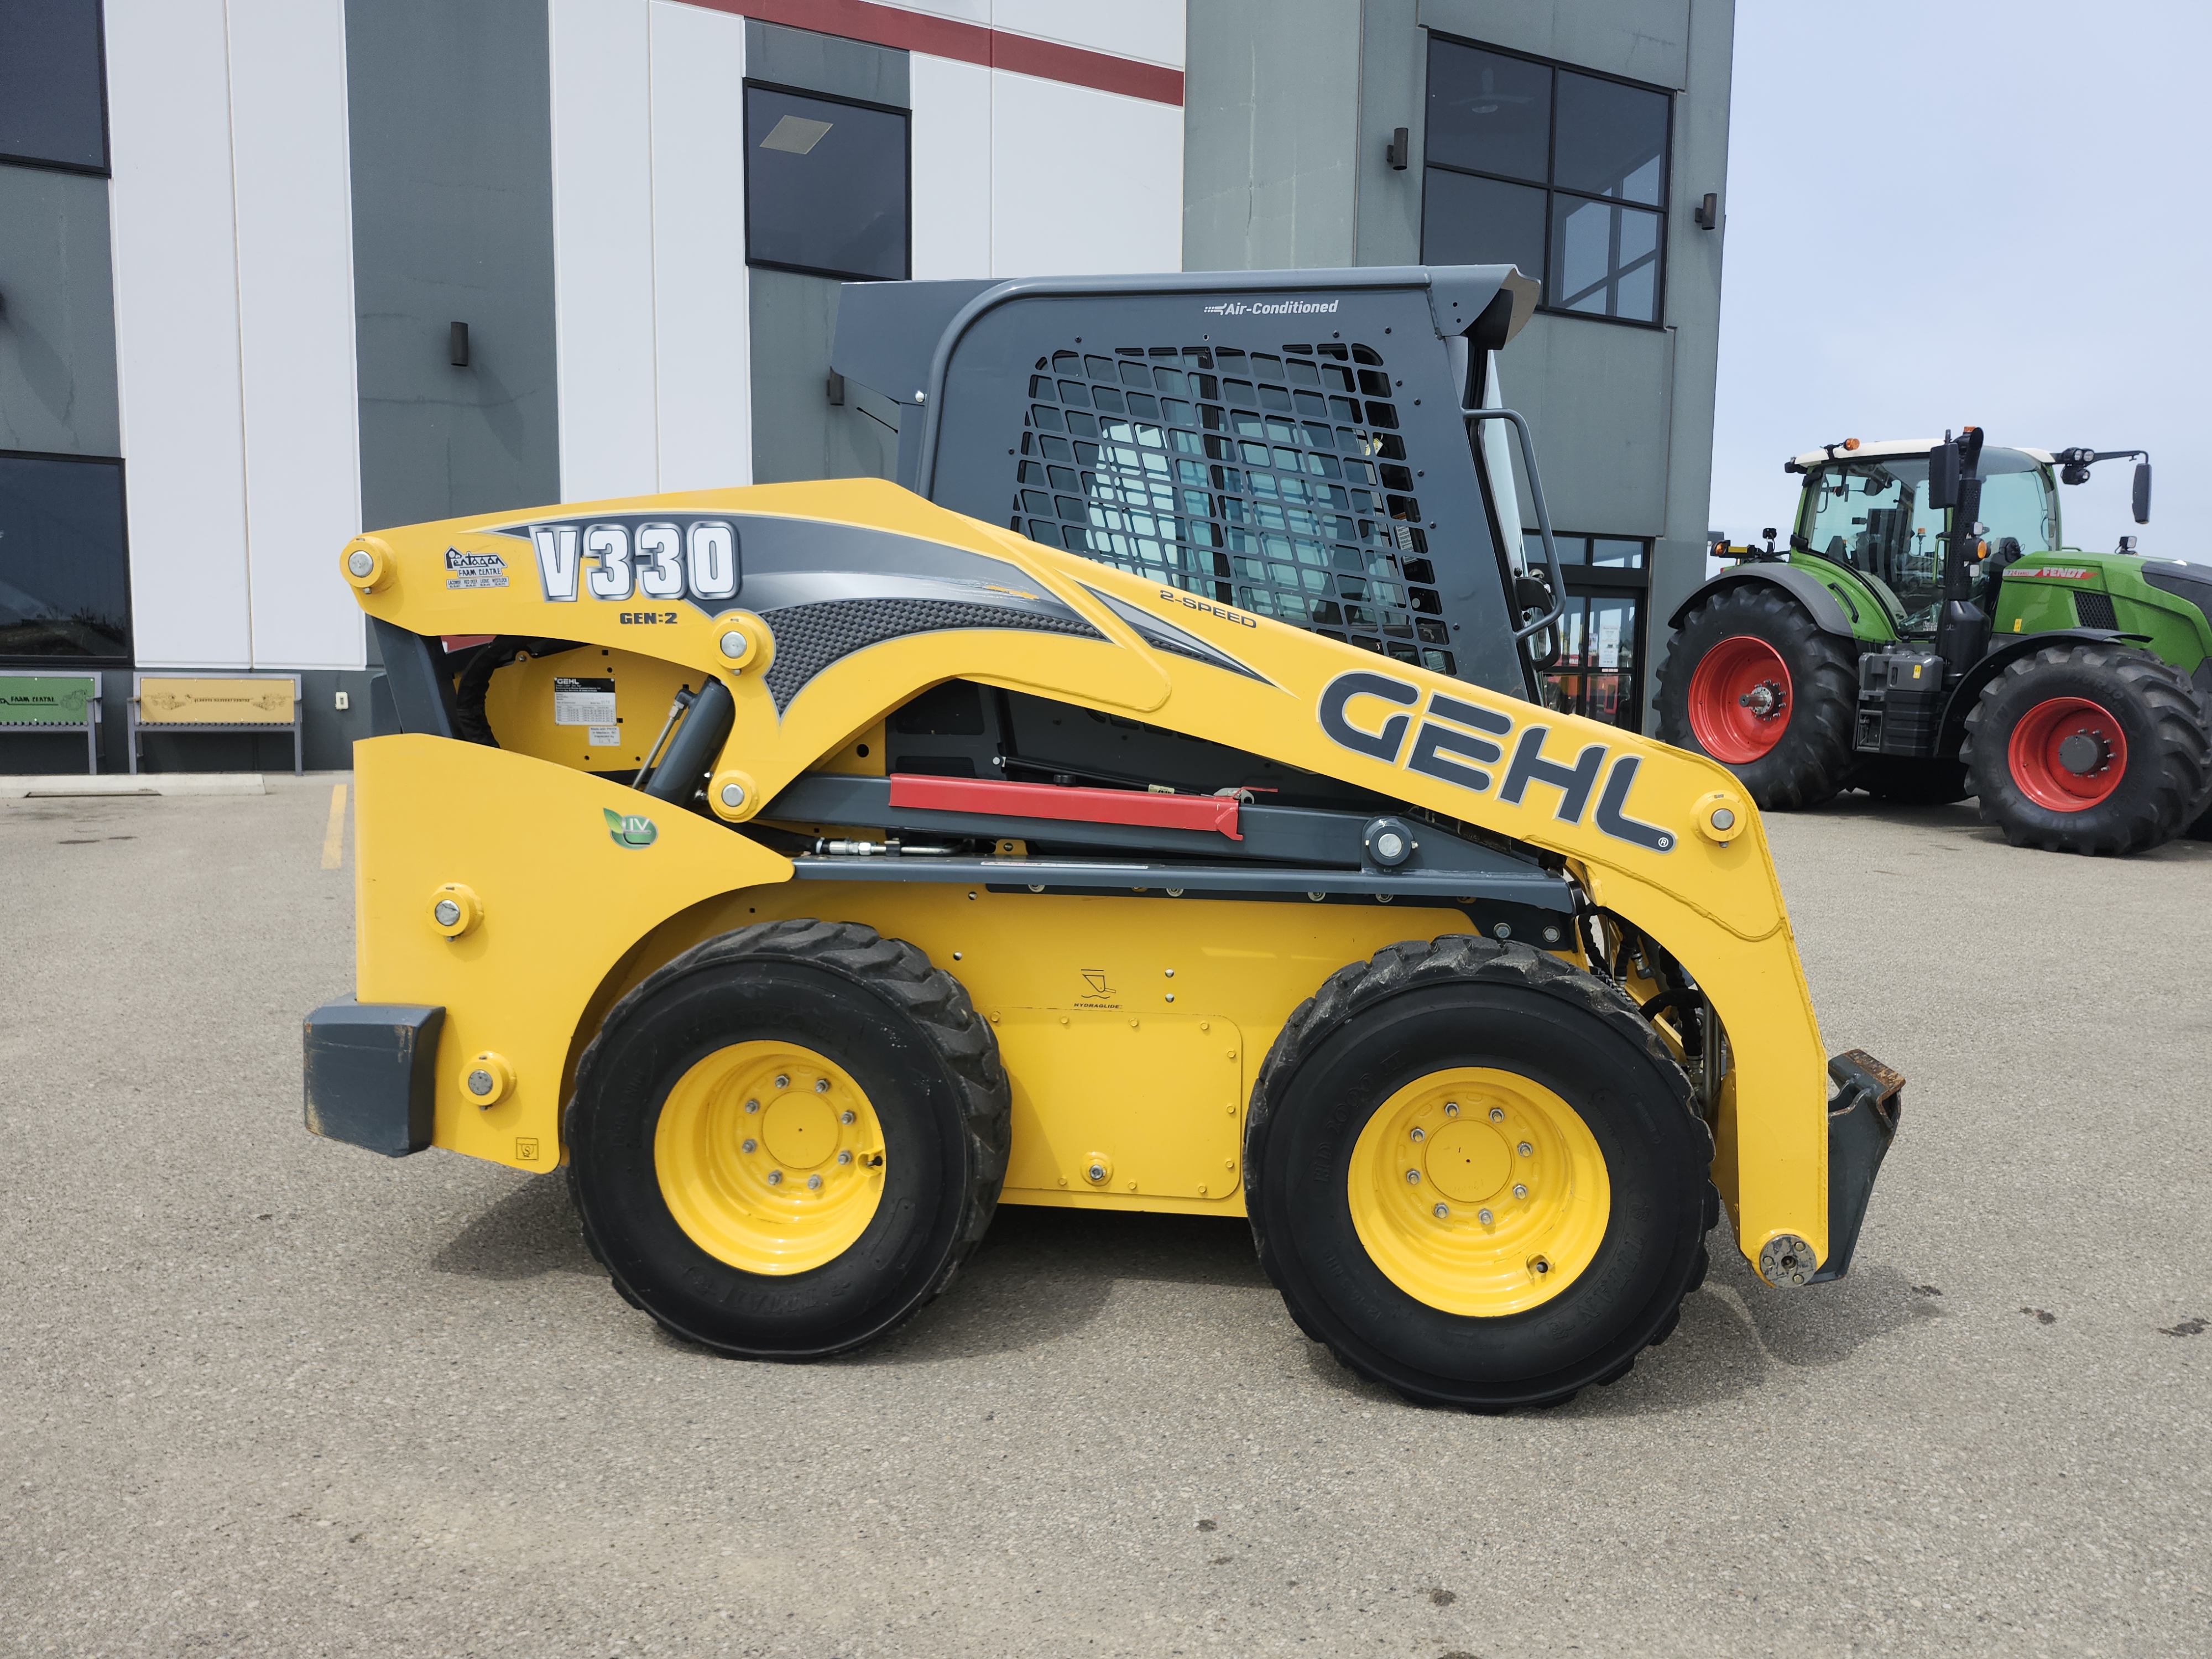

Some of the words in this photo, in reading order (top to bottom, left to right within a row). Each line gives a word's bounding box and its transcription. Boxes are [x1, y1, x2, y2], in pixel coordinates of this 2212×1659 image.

[1225, 300, 1339, 316] Air-Conditioned
[529, 521, 739, 602] V330
[2043, 567, 2086, 578] FENDT
[619, 612, 678, 625] GEN:2
[1160, 589, 1257, 629] 2-SPEED
[1318, 670, 1677, 854] GEHL
